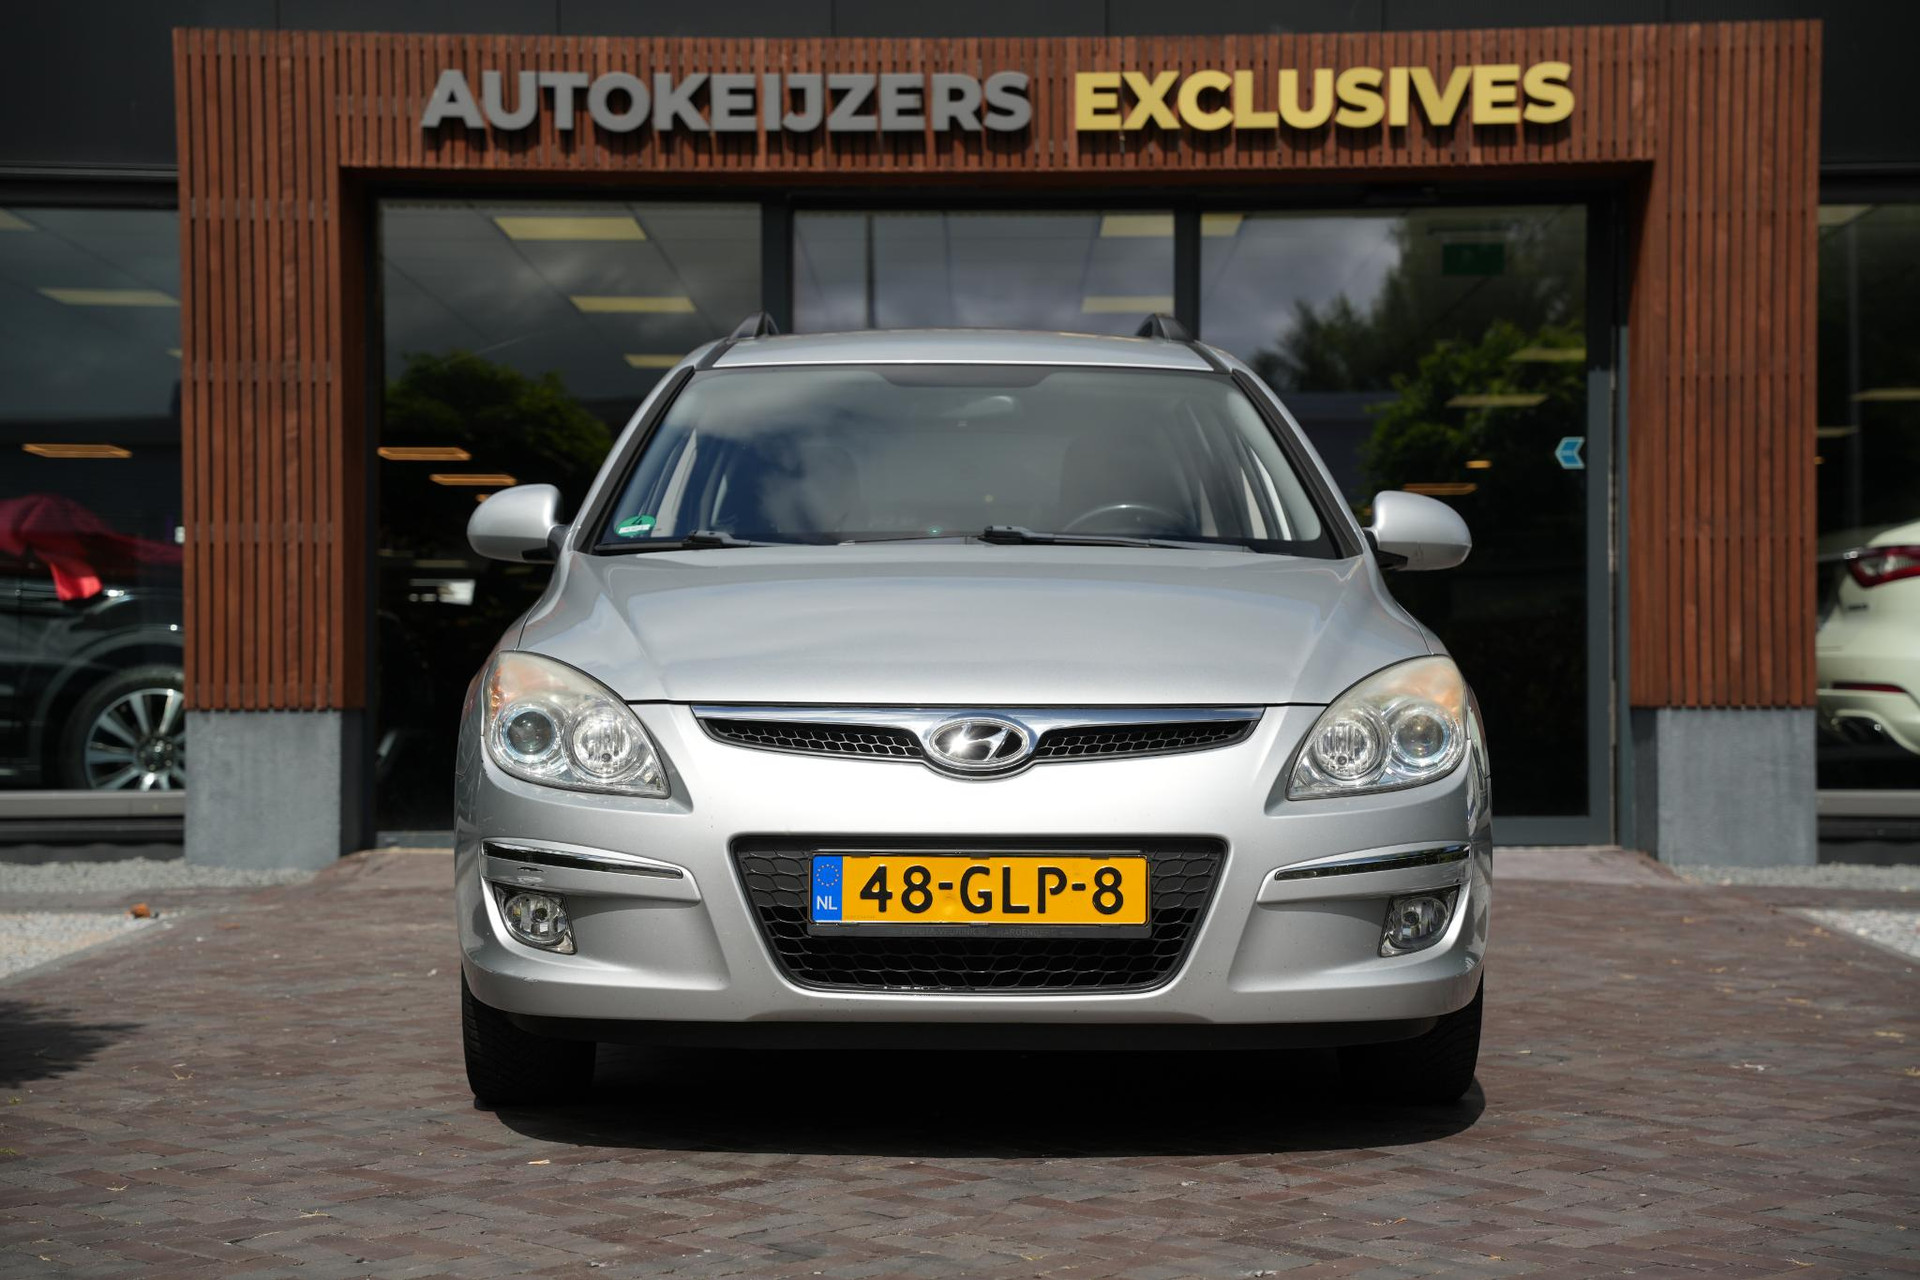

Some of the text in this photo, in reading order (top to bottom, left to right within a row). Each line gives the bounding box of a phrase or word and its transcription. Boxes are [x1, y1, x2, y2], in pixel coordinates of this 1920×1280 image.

[420, 61, 1576, 132] AUTOKEIJZERS EXCLUSIVES
[816, 895, 838, 911] NL
[859, 865, 1124, 915] 48-GLP-8
